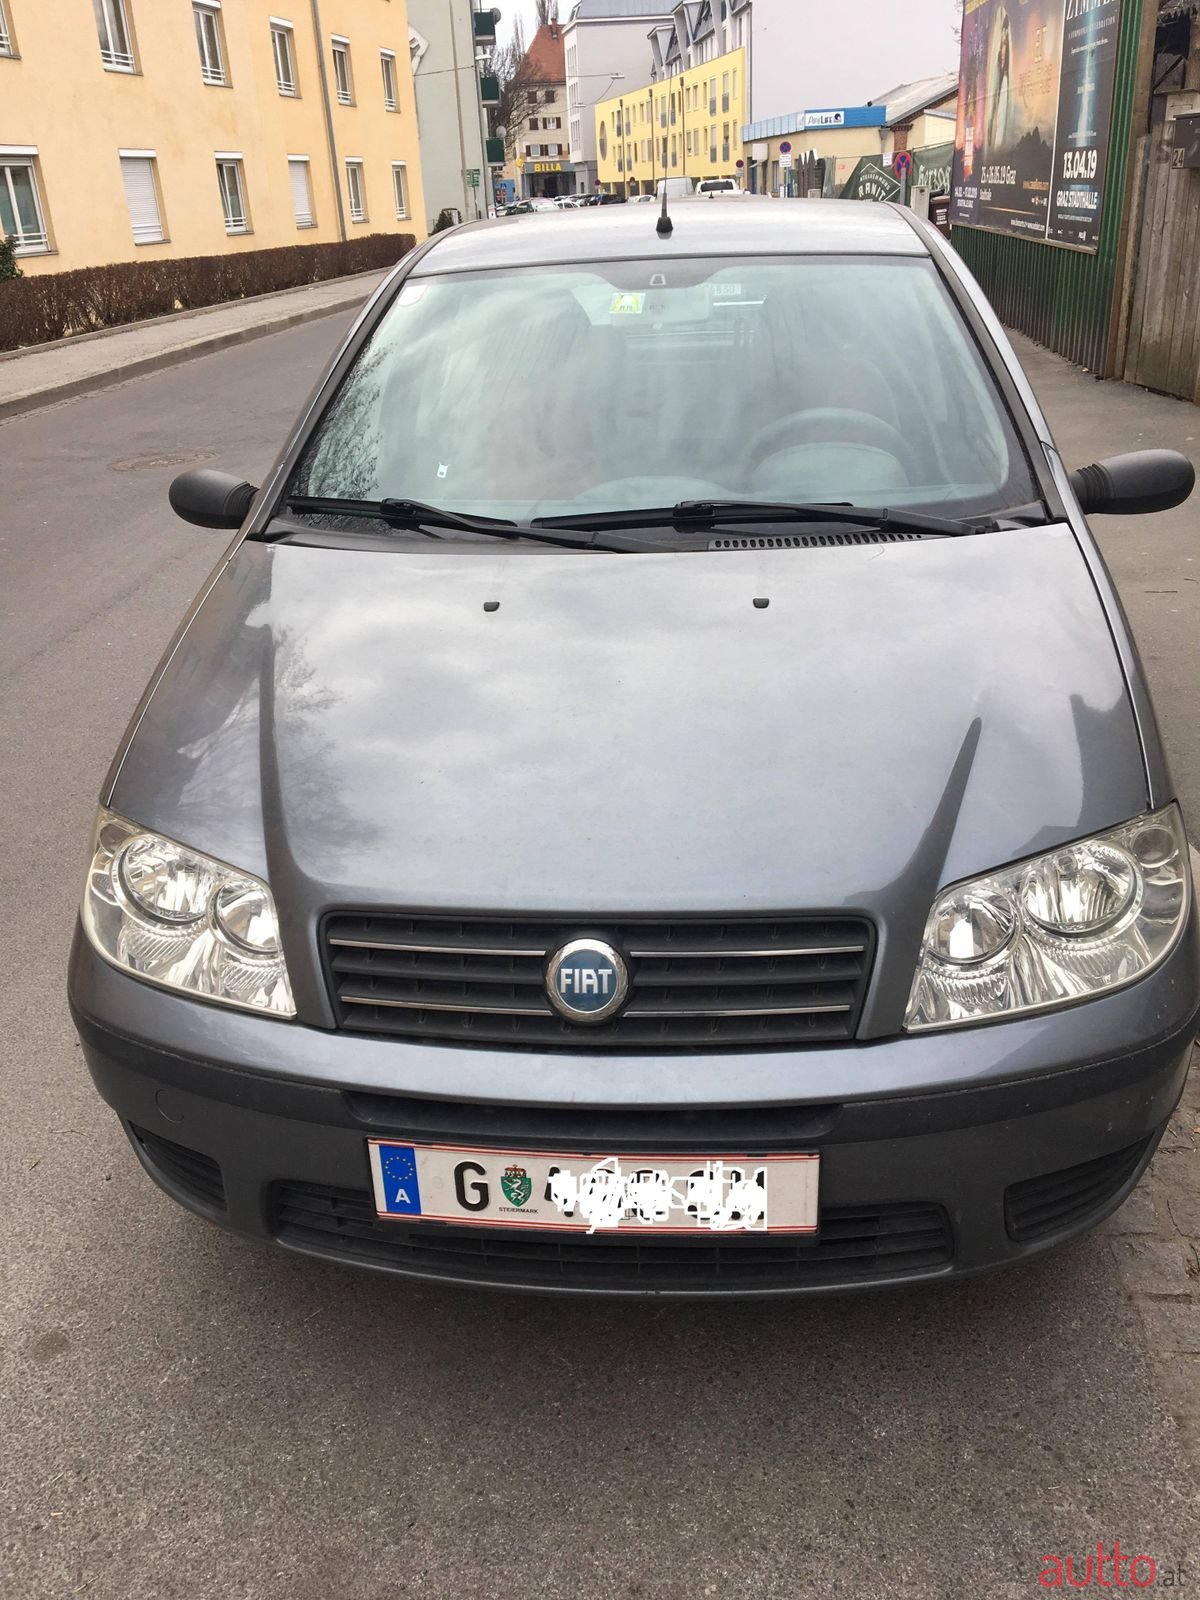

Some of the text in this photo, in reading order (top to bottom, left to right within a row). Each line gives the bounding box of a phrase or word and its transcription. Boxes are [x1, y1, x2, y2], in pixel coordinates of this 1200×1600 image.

[534, 163, 562, 172] BILLA
[1063, 150, 1097, 179] 13.04.19
[1172, 150, 1184, 167] 24
[1056, 190, 1068, 207] GRAZ
[1068, 190, 1098, 209] STADTHALLE
[560, 968, 613, 994] FIAT
[453, 1160, 490, 1212] G
[394, 1188, 411, 1204] A
[498, 1206, 539, 1214] STEIERMARK
